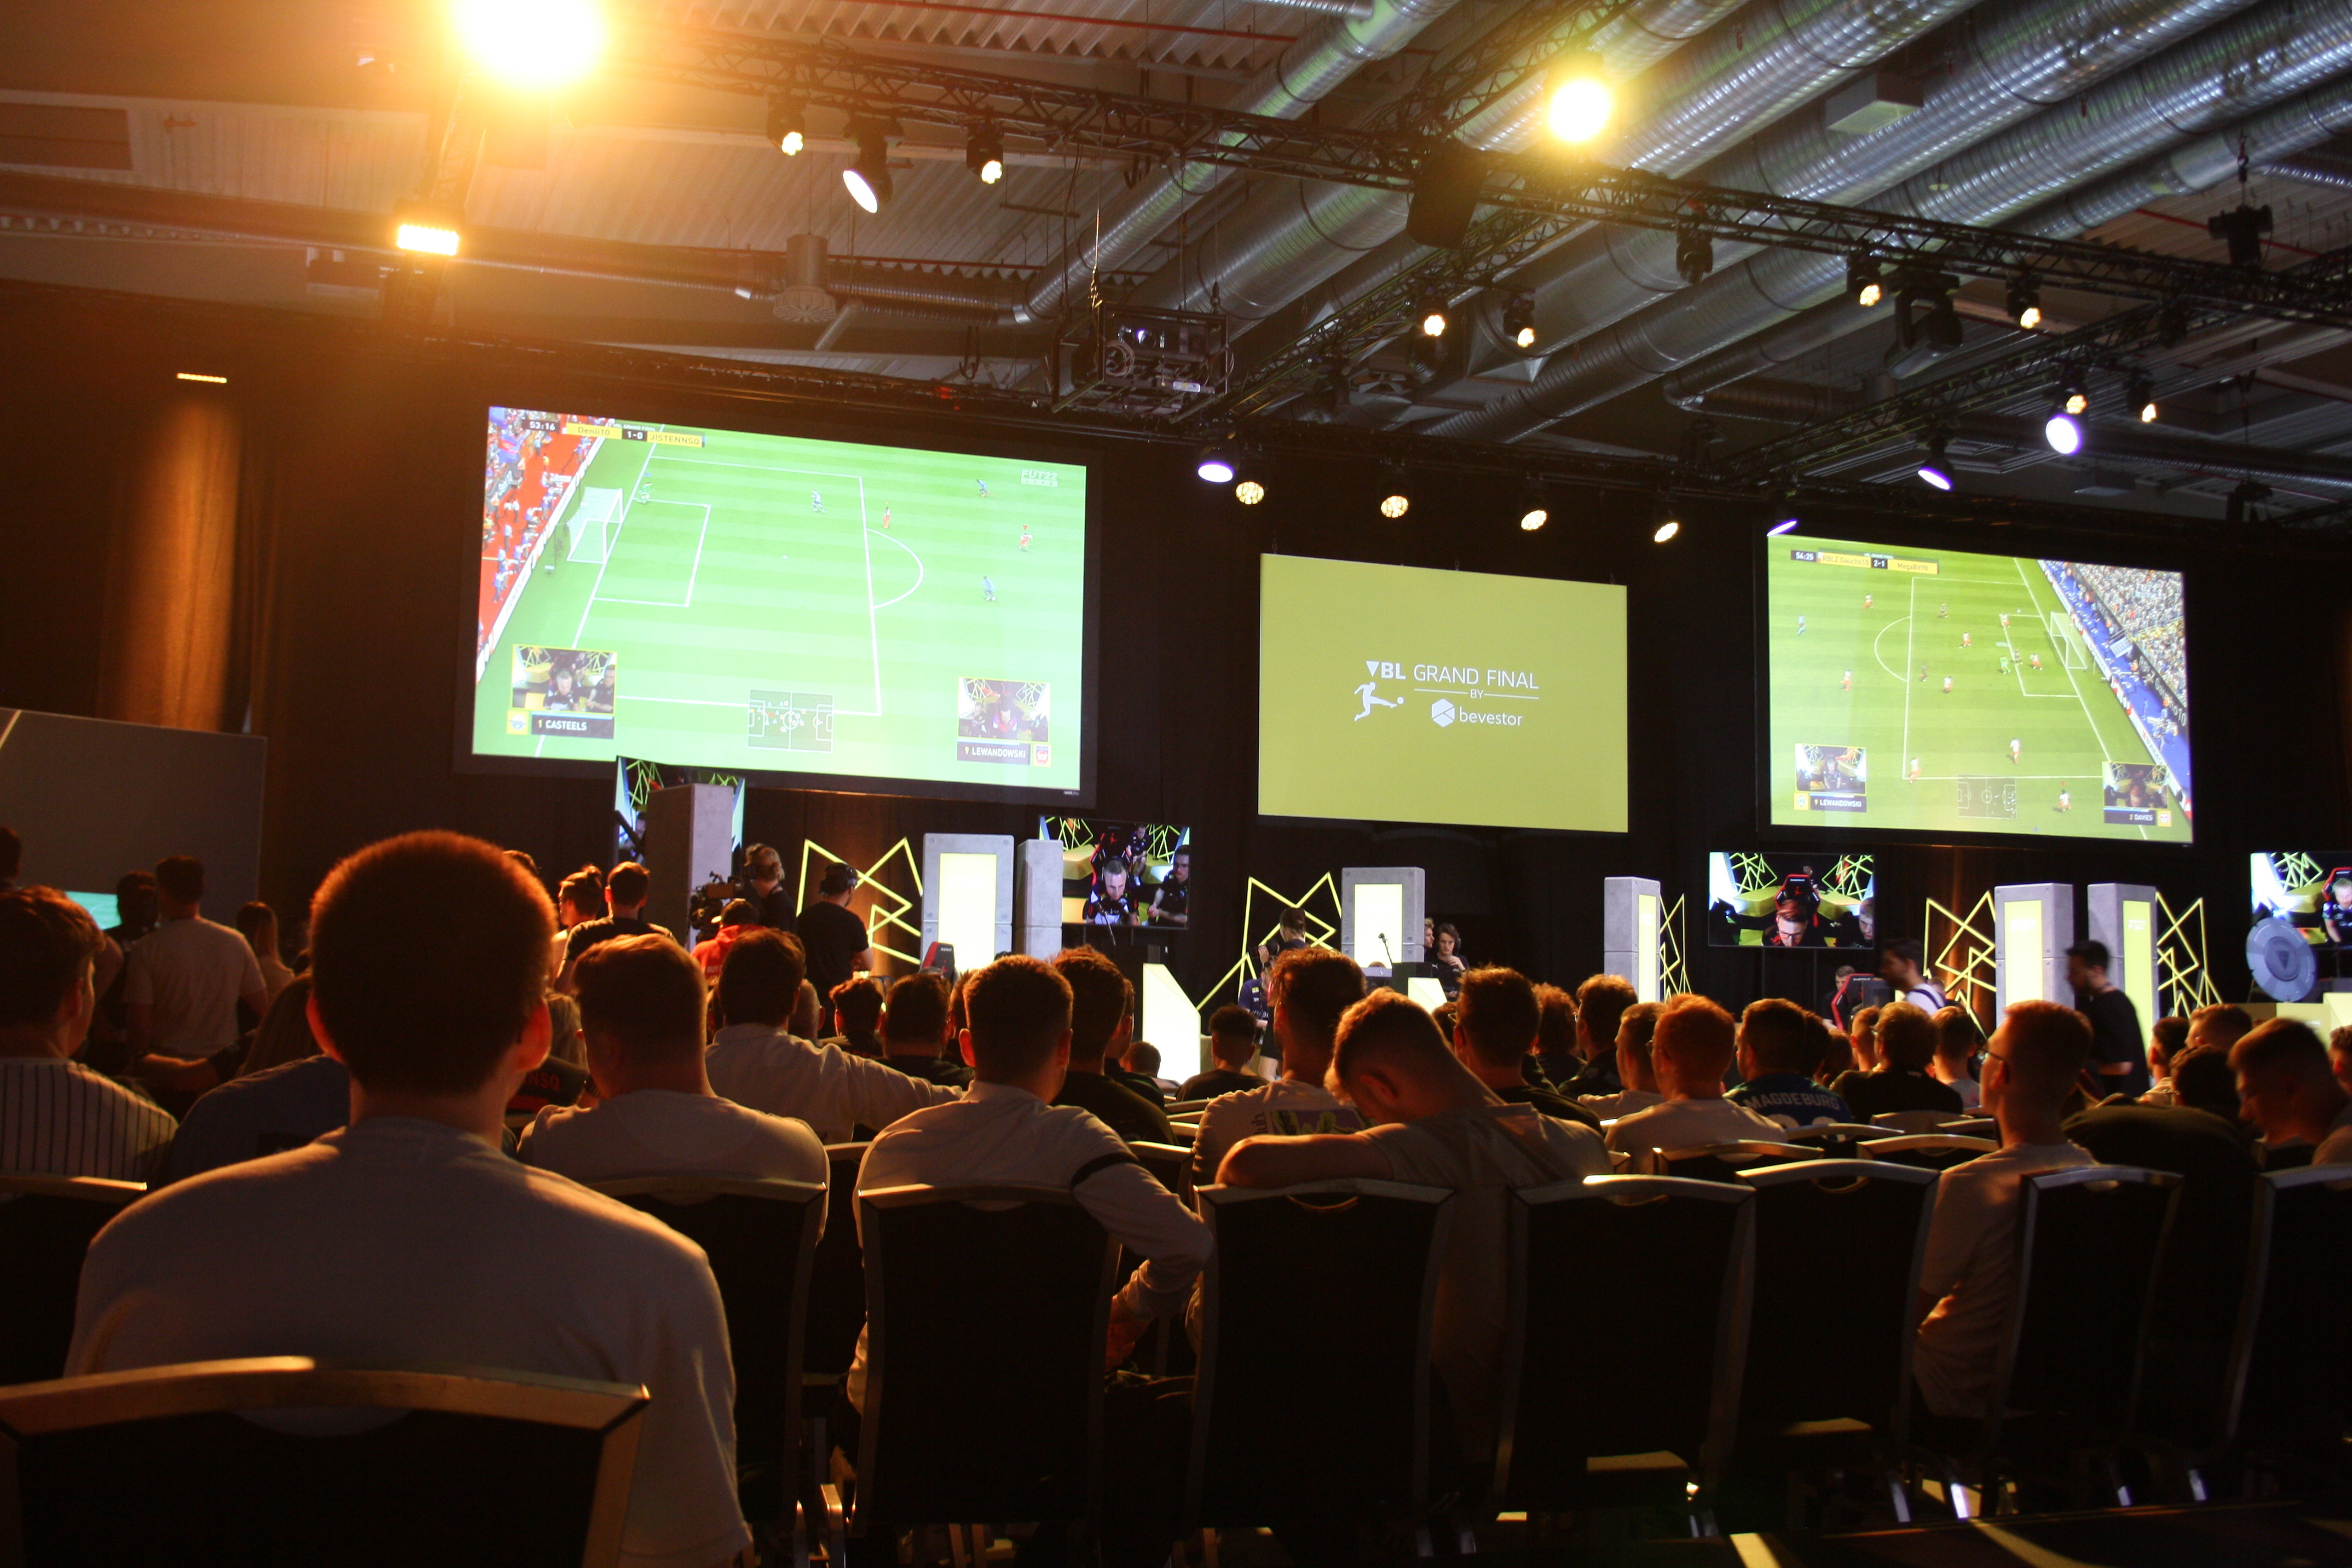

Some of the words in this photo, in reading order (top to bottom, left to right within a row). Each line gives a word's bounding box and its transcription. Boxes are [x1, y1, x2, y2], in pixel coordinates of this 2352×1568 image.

[529, 421, 556, 431] 53:16
[627, 431, 644, 440] 1-0
[1021, 469, 1058, 480] FUT22
[1365, 661, 1406, 680] VBL
[1414, 664, 1479, 685] GRAND
[1487, 670, 1540, 690] FINAL
[1470, 688, 1485, 699] BY
[1459, 706, 1523, 727] bevestor
[538, 719, 543, 728] 1
[545, 720, 587, 731] CASTEELS
[964, 746, 969, 755] 9
[972, 747, 1026, 759] LEWANDOWSKI
[1820, 799, 1861, 808] LEWANDOWSKI
[1742, 1093, 1840, 1111] MAGDEBURG
